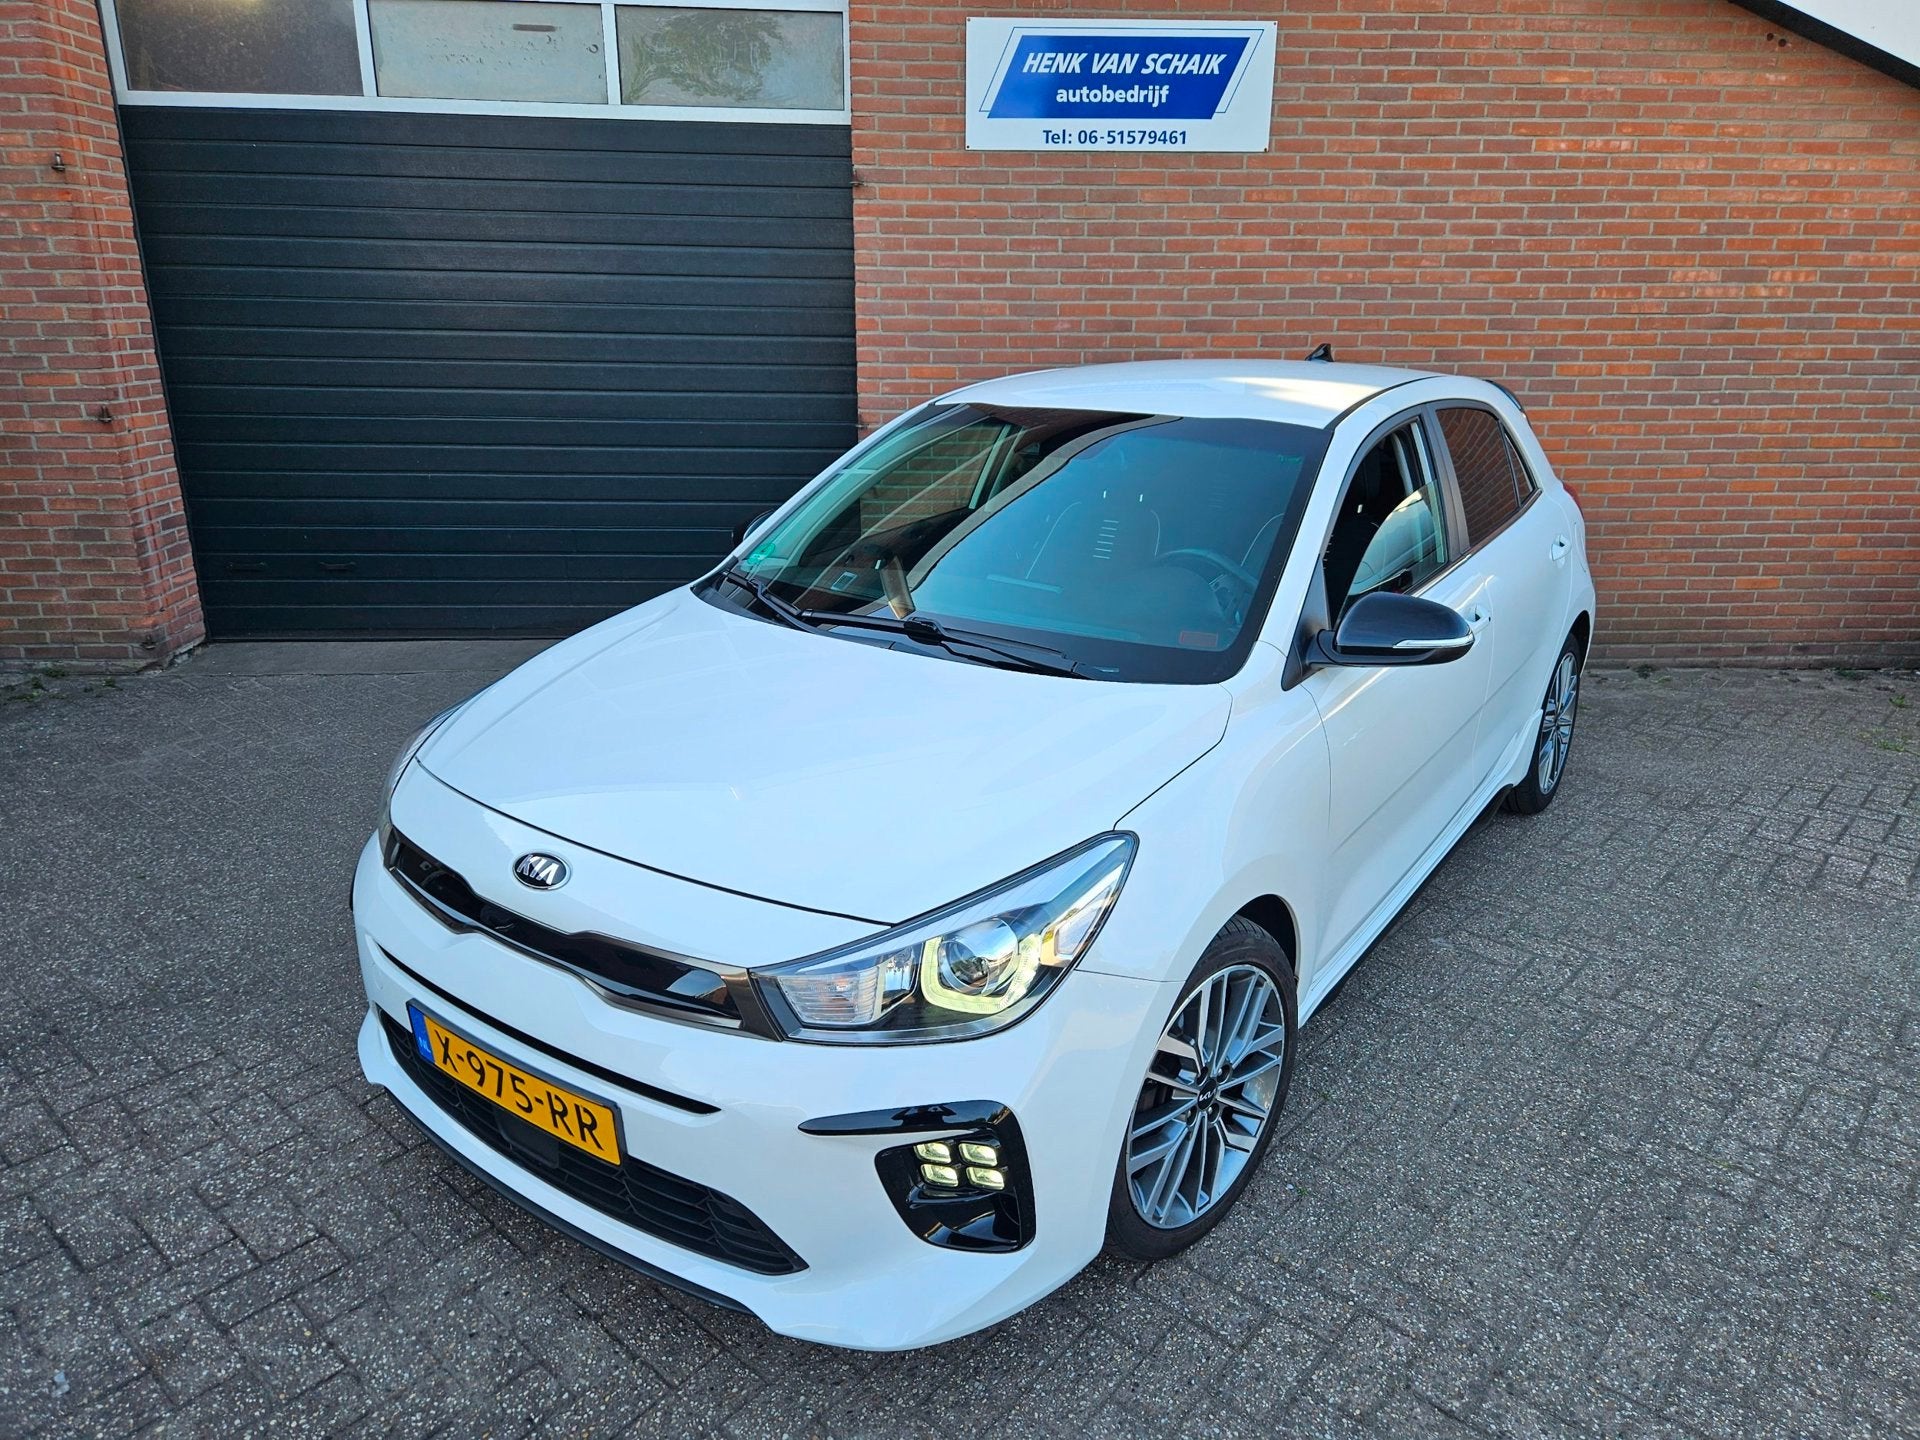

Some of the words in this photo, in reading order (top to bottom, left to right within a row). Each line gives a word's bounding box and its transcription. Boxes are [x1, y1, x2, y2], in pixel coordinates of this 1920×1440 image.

[1022, 52, 1088, 74] HENK
[1091, 53, 1137, 74] VAN
[1140, 53, 1227, 75] SCHAIK
[1056, 85, 1169, 107] autobedrijf
[1043, 129, 1072, 144] Tel:
[1077, 130, 1187, 145] 06-51579461
[516, 854, 559, 885] KIA
[434, 1029, 605, 1151] X-975-RR
